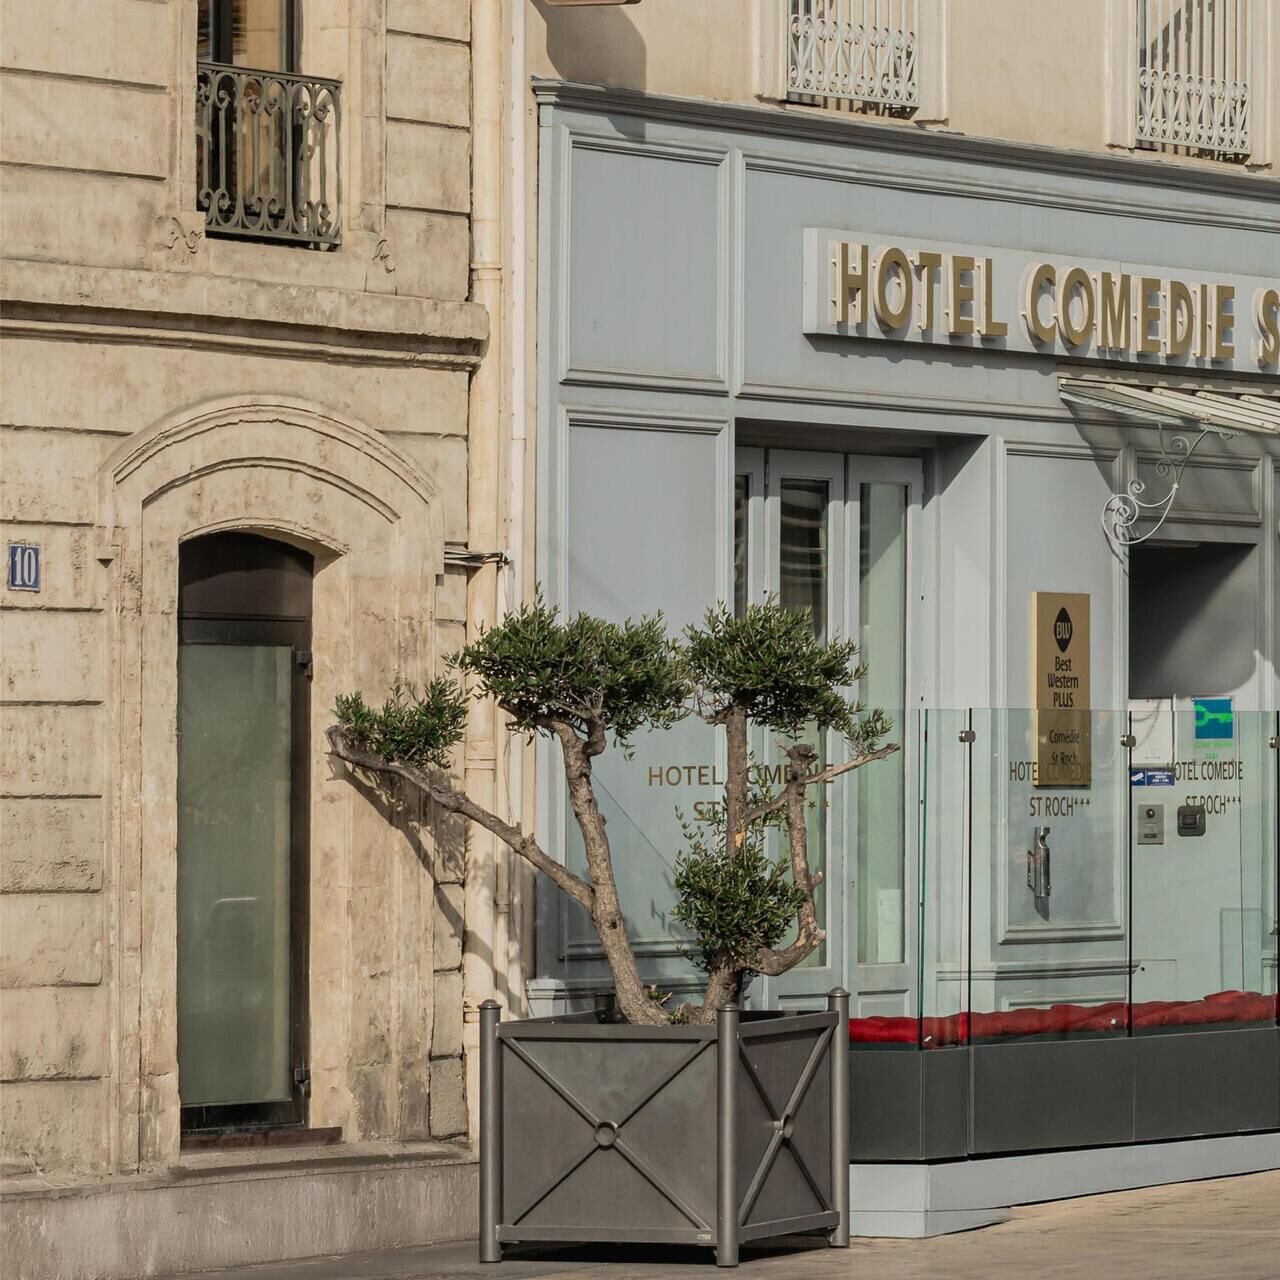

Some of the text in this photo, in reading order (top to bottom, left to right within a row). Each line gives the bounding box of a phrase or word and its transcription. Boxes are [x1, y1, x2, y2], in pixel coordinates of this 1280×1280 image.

[836, 242, 1008, 337] HOTEL
[1026, 263, 1235, 360] COMEDIE
[15, 547, 36, 586] 10
[1056, 621, 1071, 639] BW
[1055, 656, 1072, 672] Best
[1047, 673, 1079, 689] Western
[1053, 692, 1074, 708] PLUS
[1049, 729, 1080, 745] Comédie
[1051, 752, 1077, 766] St Roch
[648, 765, 723, 786] HOTEL
[1009, 761, 1043, 781] HOTEL
[1201, 761, 1243, 781] COMEDIE
[1030, 797, 1074, 817] ST ROCH
